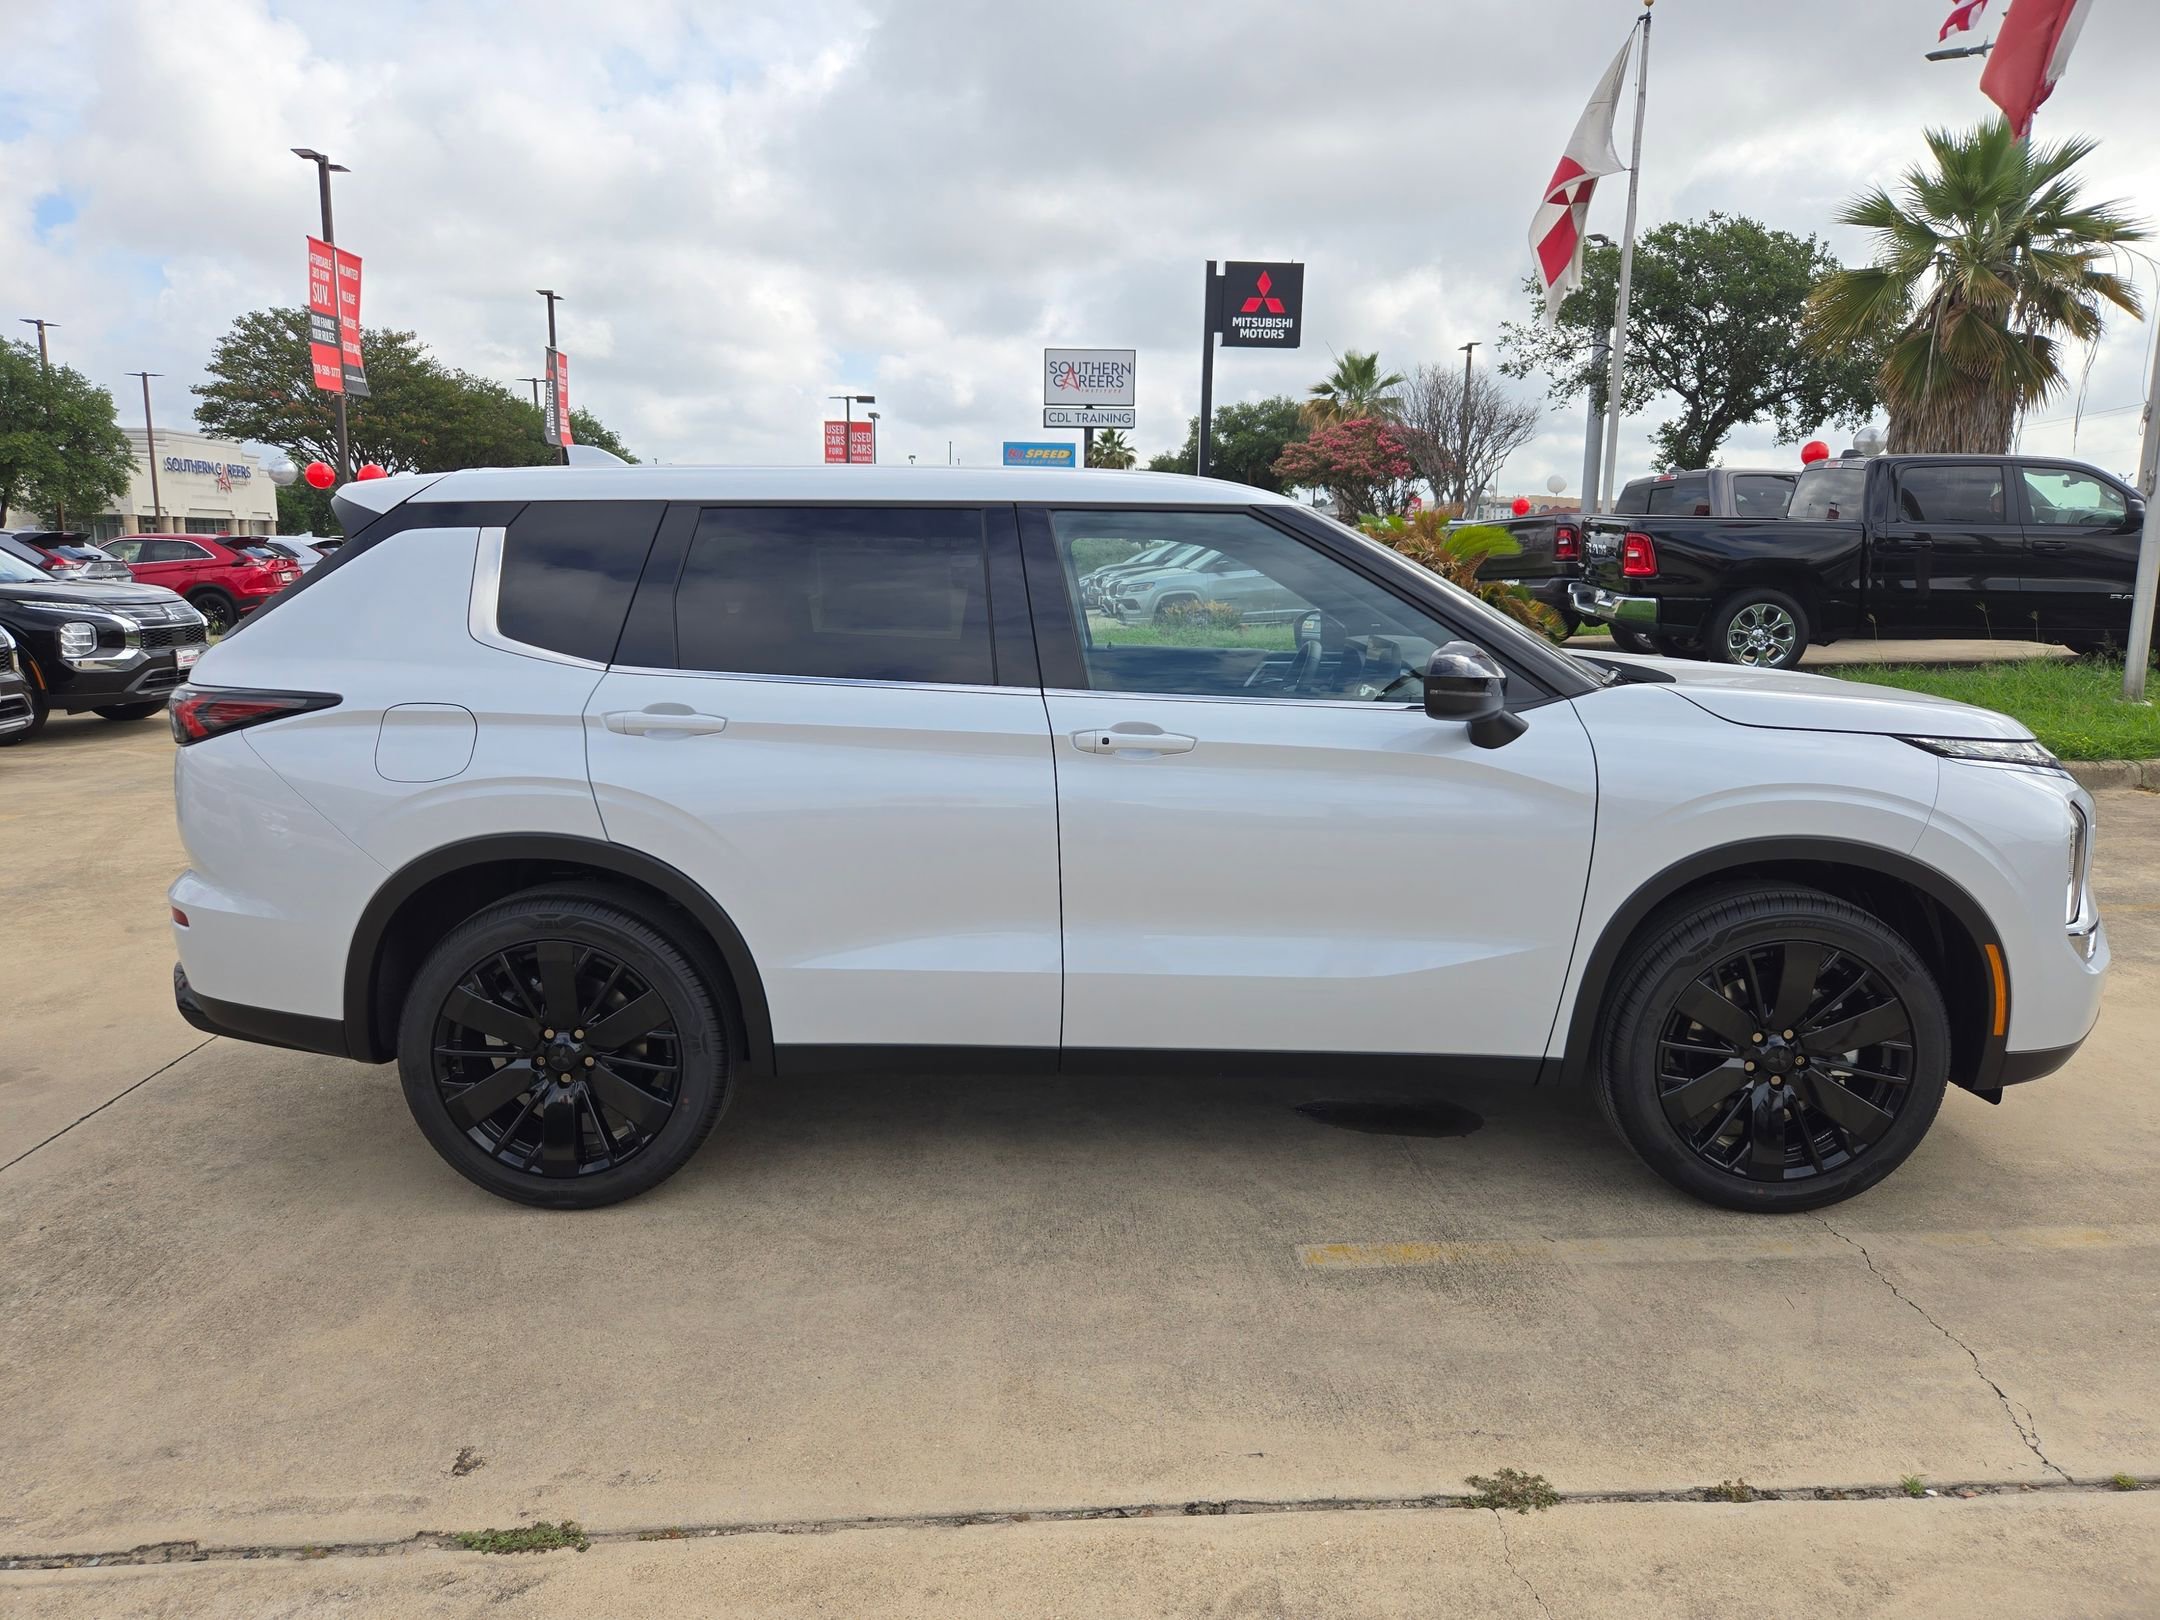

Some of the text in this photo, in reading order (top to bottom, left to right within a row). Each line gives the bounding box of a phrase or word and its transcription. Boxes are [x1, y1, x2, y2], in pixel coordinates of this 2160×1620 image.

[312, 281, 331, 307] SUV.
[1232, 316, 1293, 329] MITSUBISHI
[1239, 328, 1285, 339] MOTORS
[1049, 360, 1131, 375] SOUTHERN
[1053, 373, 1124, 390] CAREERS
[1048, 412, 1132, 424] CDL TRAINING
[826, 424, 845, 435] USED
[826, 435, 846, 446] CARS
[851, 432, 872, 443] USED
[851, 444, 872, 455] CARS
[1025, 449, 1072, 459] SPEED
[165, 456, 251, 486] SOUTHERN CAREERS
